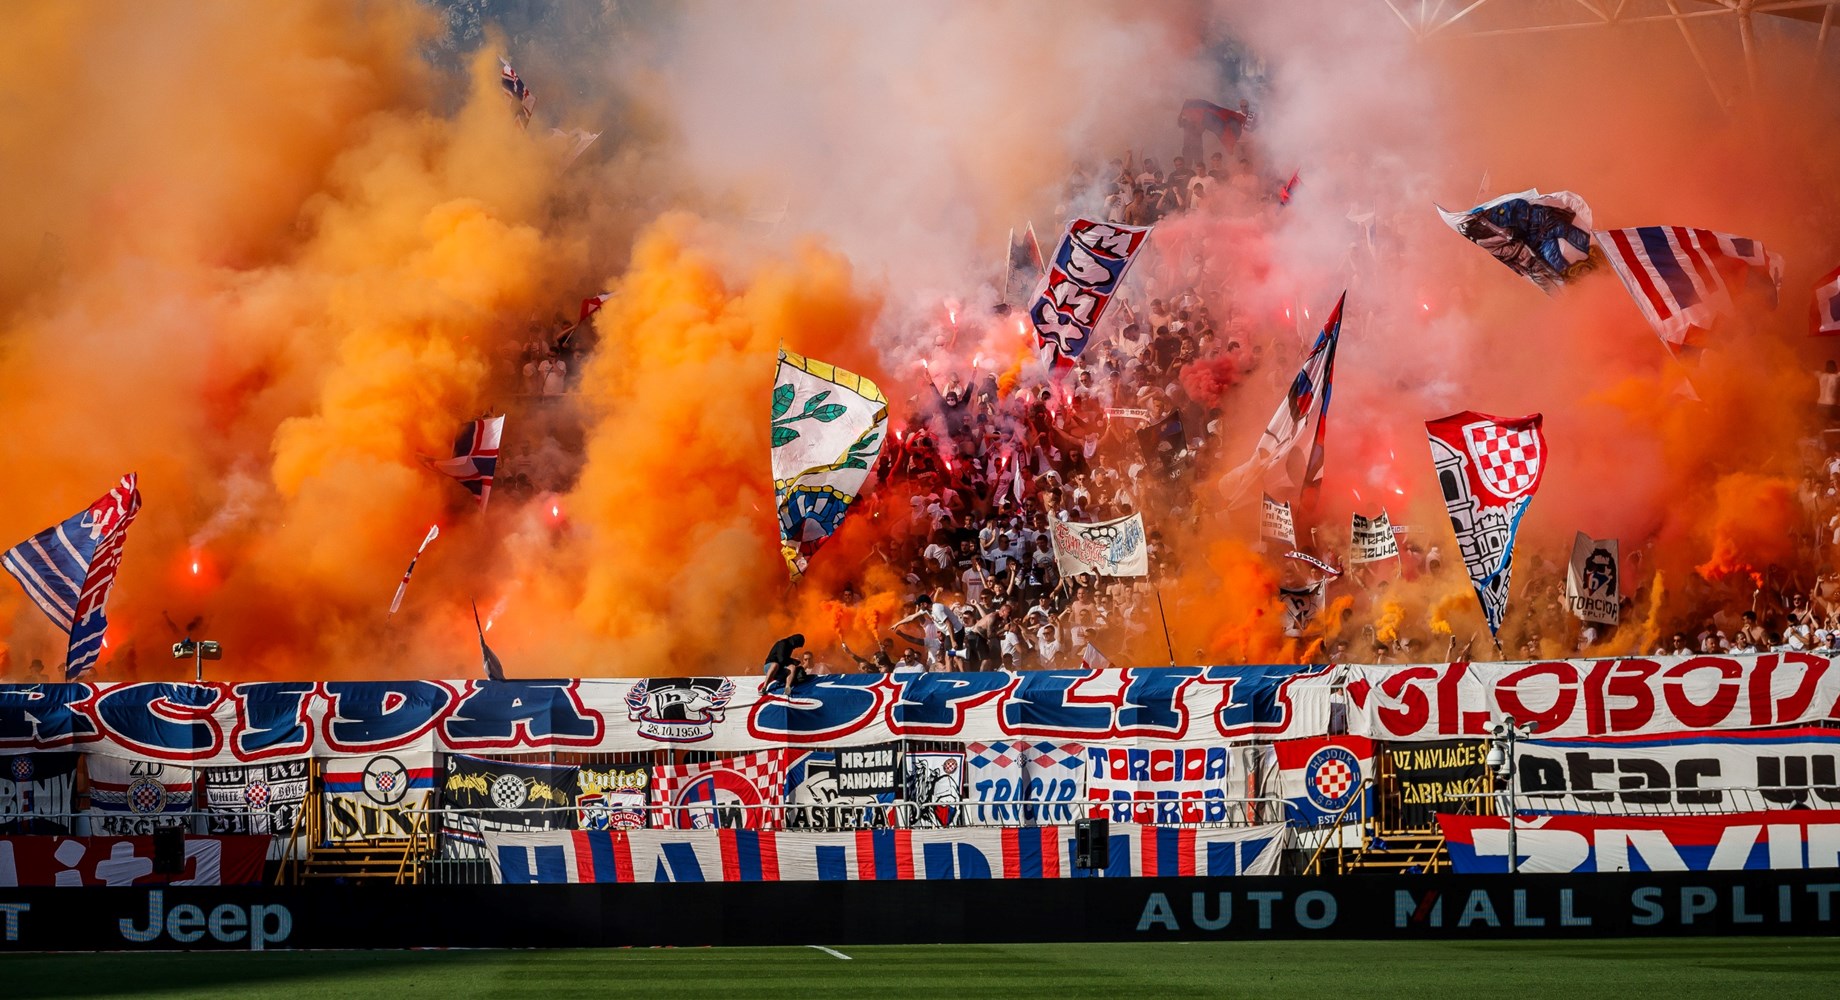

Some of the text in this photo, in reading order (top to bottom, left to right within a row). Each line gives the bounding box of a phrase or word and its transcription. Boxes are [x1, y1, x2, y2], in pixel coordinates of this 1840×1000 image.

[747, 664, 1336, 743] SPLIT
[1378, 652, 1840, 737] SLOBOD
[647, 724, 704, 737] 28.10.1950.
[841, 750, 893, 769] MRZIN
[1087, 747, 1227, 782] TORCIDA
[1311, 749, 1353, 769] HAJDUK
[1393, 751, 1412, 770] UZ
[1414, 743, 1475, 771] NAVIJAČE
[577, 768, 648, 790] United
[840, 771, 894, 789] PANDURE
[278, 784, 304, 799] BOYS
[1341, 812, 1357, 822] 911
[119, 890, 293, 950] Jeep
[1136, 891, 1338, 931] AUTO
[1395, 888, 1592, 928] MALL
[1631, 883, 1840, 925] SPLIT
